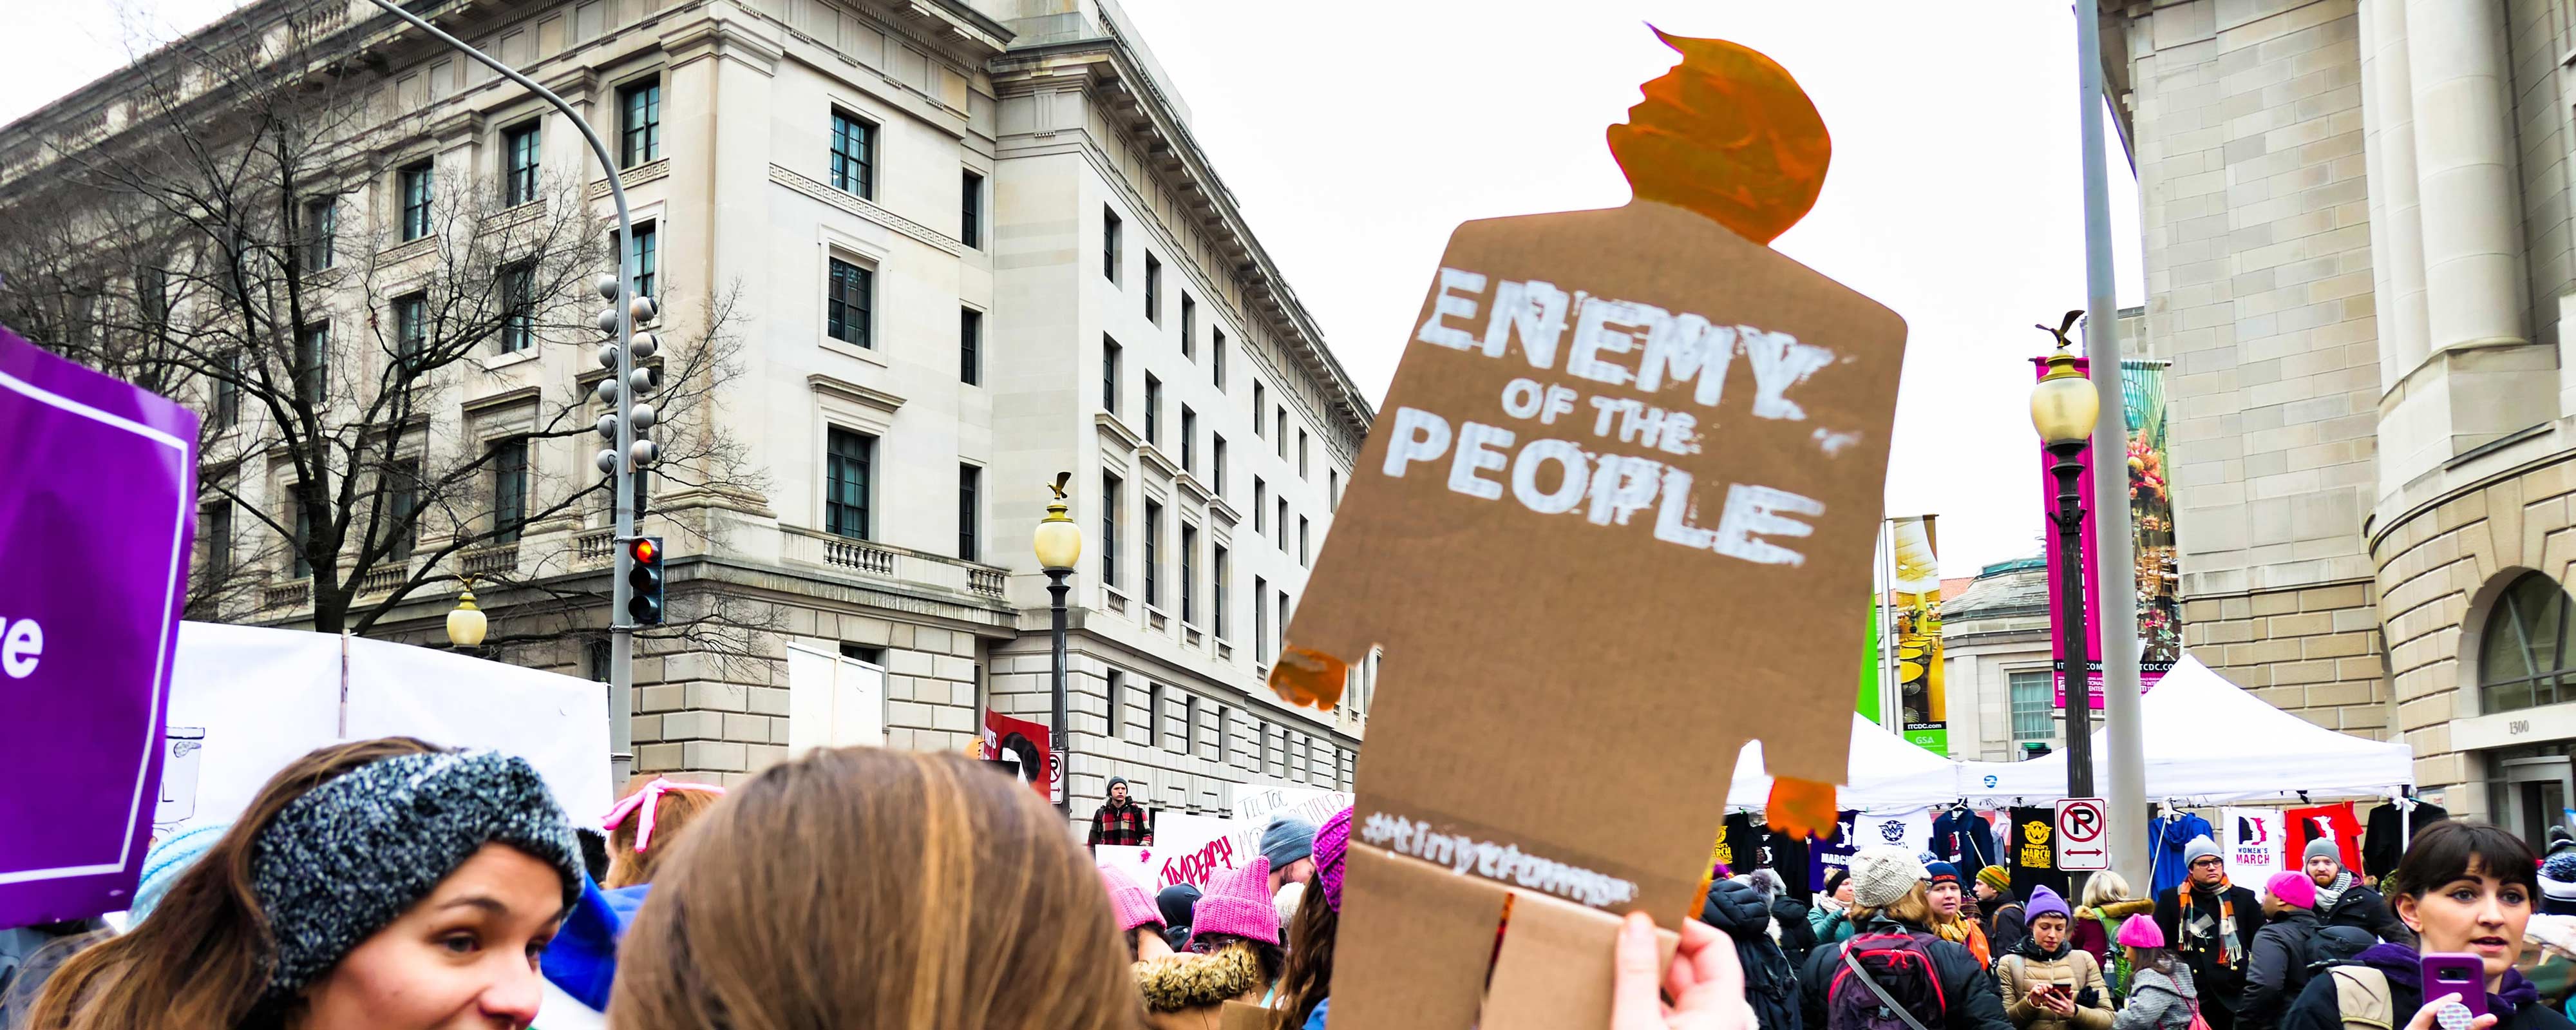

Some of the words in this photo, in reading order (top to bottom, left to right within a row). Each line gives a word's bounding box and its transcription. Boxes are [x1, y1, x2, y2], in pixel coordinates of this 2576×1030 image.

[1417, 267, 1835, 421] ENEMY
[1501, 377, 1578, 424] OF
[1589, 394, 1703, 455] THE
[1383, 406, 1826, 567] PEOPLE
[2509, 720, 2530, 735] 1300
[1260, 789, 1288, 810] TOC
[1160, 835, 1233, 892] IMPEACH
[2022, 848, 2050, 859] MARCH
[2236, 854, 2269, 864] MARCH
